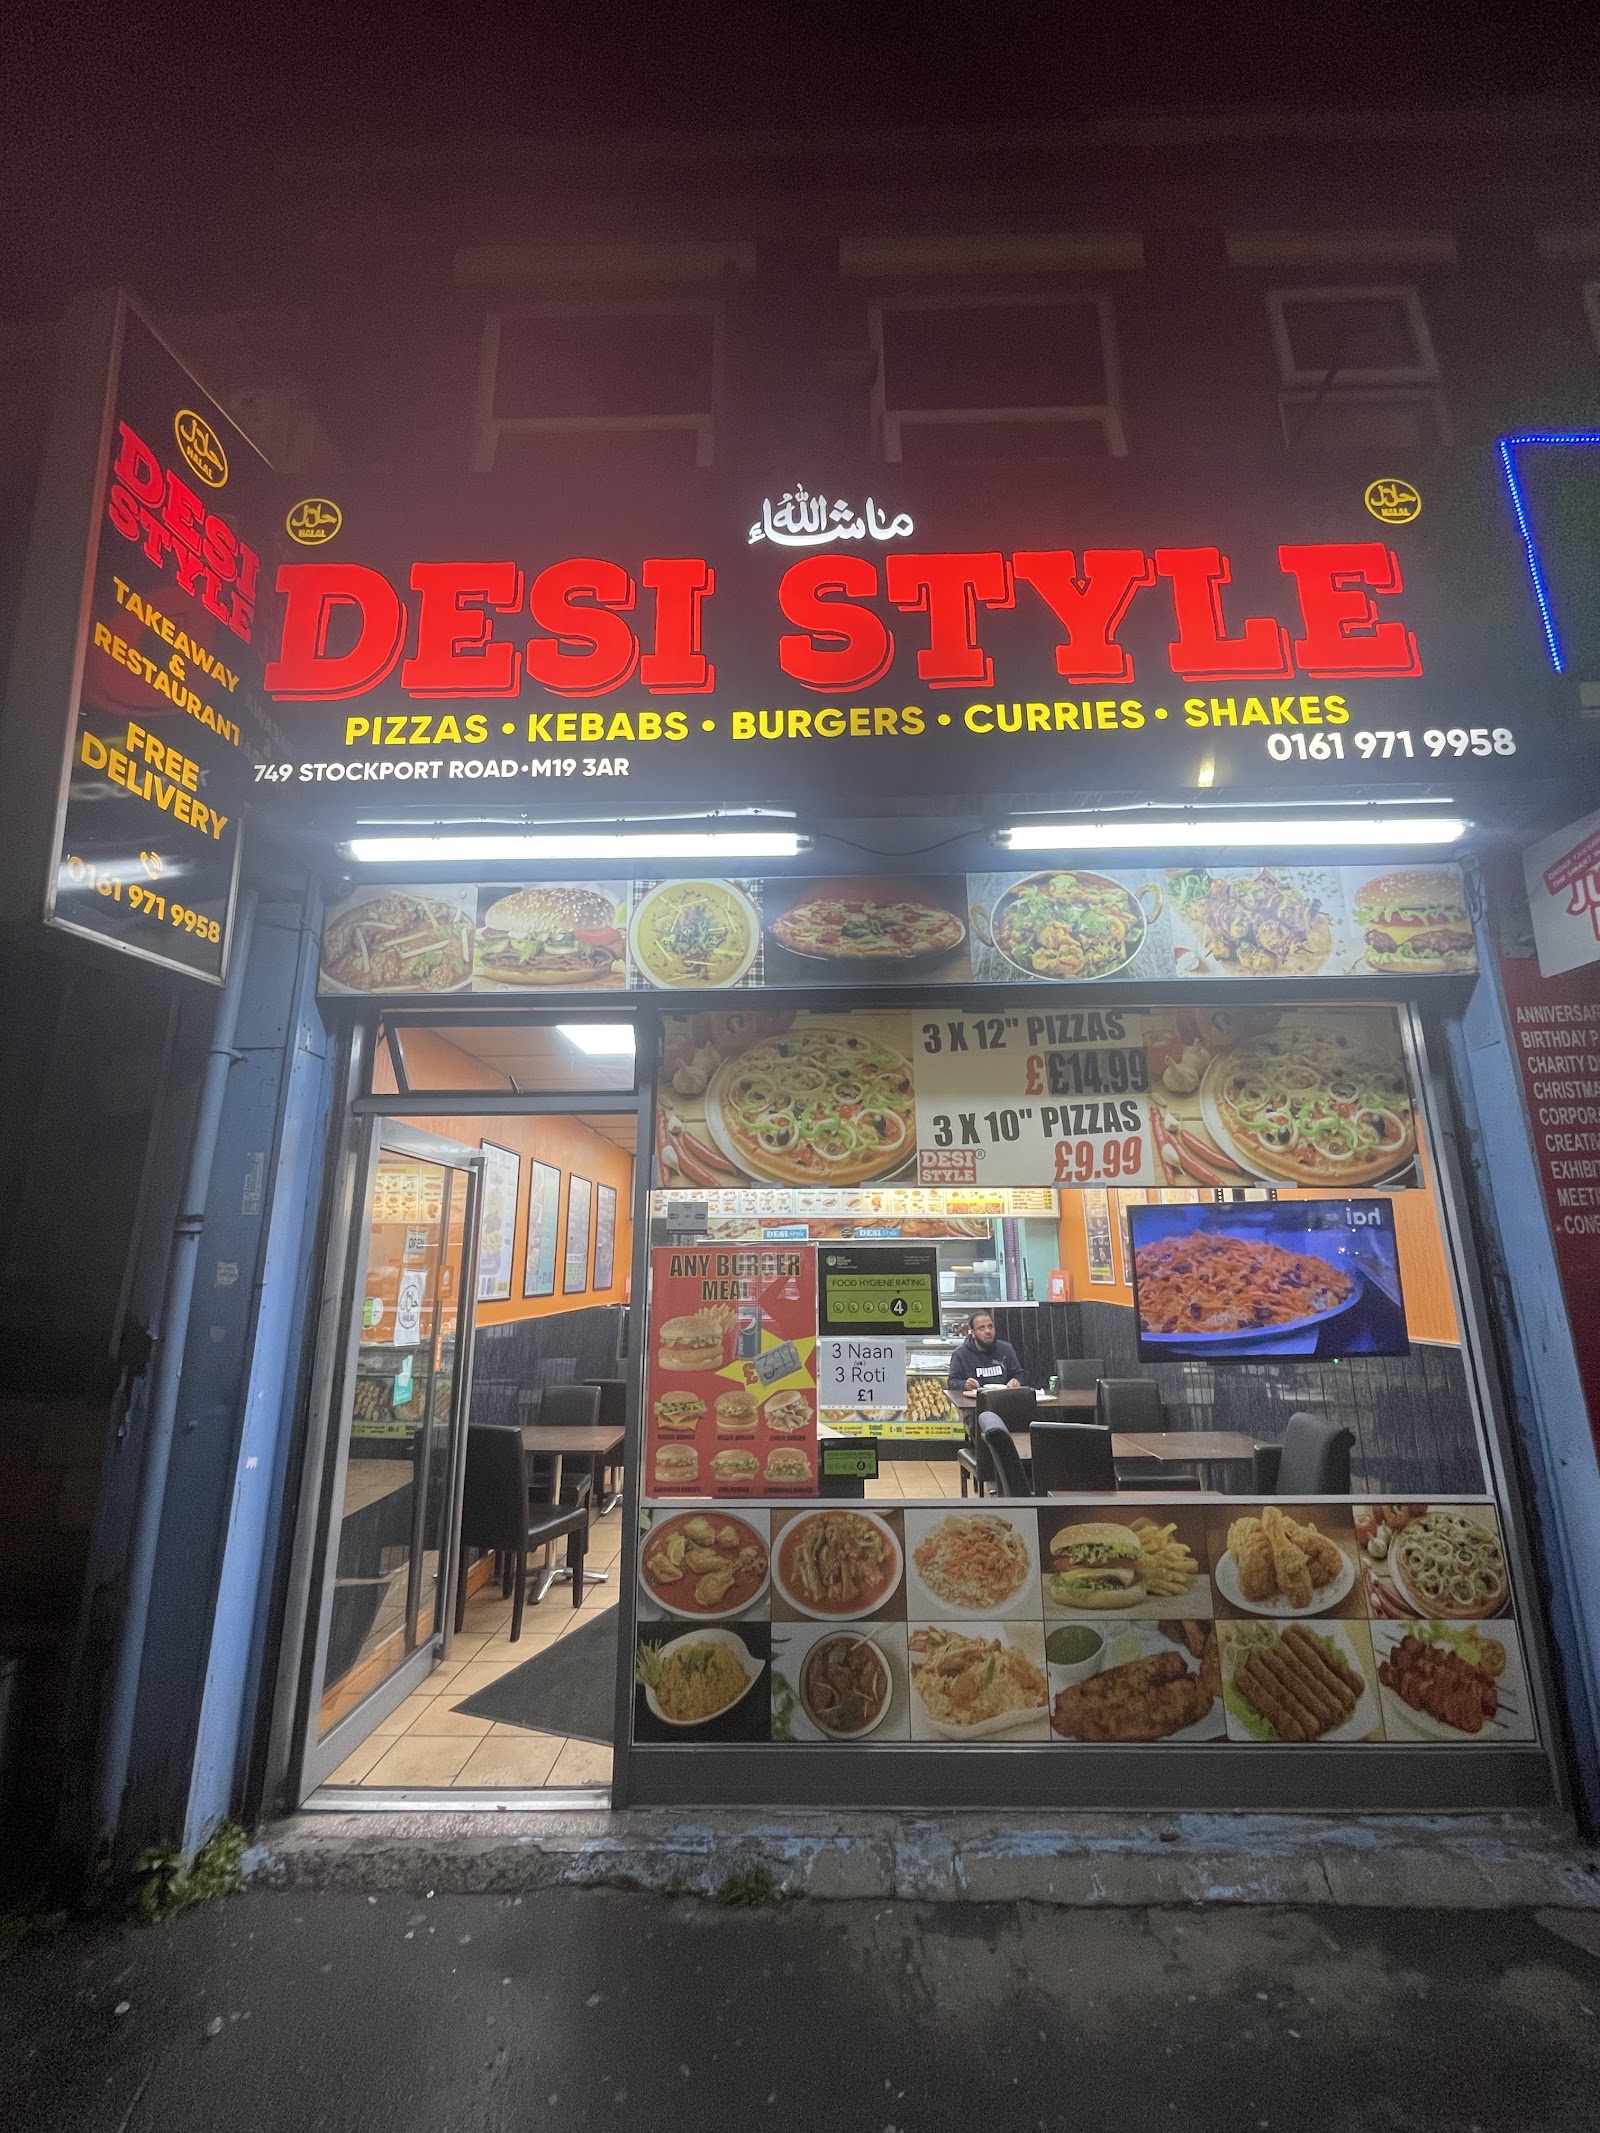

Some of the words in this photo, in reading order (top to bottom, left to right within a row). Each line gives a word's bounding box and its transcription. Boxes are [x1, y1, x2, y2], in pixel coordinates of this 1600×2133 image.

[114, 420, 260, 606] DESI
[108, 484, 255, 643] STYLE
[113, 575, 240, 693] TAKEAWAY
[263, 557, 715, 701] DESI
[778, 542, 1423, 694] STYLE
[168, 654, 186, 681] &
[94, 621, 241, 747] RESTAURANT
[345, 714, 489, 746] PIZZAS
[527, 711, 689, 743] KEBABS
[732, 706, 926, 740] BURGERS
[964, 700, 1146, 734] CURRIES
[1184, 695, 1350, 728] SHAKES
[126, 721, 200, 792] FREE
[1267, 732, 1345, 761] 0161
[1353, 730, 1415, 759] 971
[1423, 728, 1517, 758] 9958
[253, 764, 294, 782] 749
[299, 760, 443, 782] STOCKPORT
[582, 757, 630, 777] 3AR
[81, 730, 228, 840] DELIVERY
[67, 856, 121, 901] 0161
[128, 884, 165, 920] 971
[170, 904, 221, 943] 9958
[922, 1023, 942, 1054] 3
[947, 1021, 969, 1052] X
[1026, 1010, 1126, 1046] PIZZAS
[1521, 1029, 1586, 1049] BIRTHDAY
[1048, 1051, 1149, 1095] £14.99
[1527, 1055, 1584, 1074] CHARITY
[932, 1115, 953, 1147] 3
[958, 1112, 981, 1145] X
[1040, 1100, 1142, 1138] PIZZAS
[1539, 1107, 1600, 1126] CORPOR
[921, 1150, 975, 1168] DESI
[1053, 1136, 1142, 1182] £9.99
[922, 1169, 975, 1181] STYLE
[669, 1253, 711, 1277] ANY
[715, 1253, 801, 1277] BURGER
[702, 1280, 749, 1301] MEAL
[832, 1279, 857, 1287] FOOD
[859, 1279, 894, 1287] HYGIENE
[895, 1278, 926, 1286] RATING
[893, 1300, 904, 1315] 4
[832, 1342, 842, 1359] 3
[848, 1342, 893, 1359] Naan
[835, 1366, 845, 1383] 3
[852, 1366, 885, 1383] Roti
[857, 1388, 874, 1402] £1
